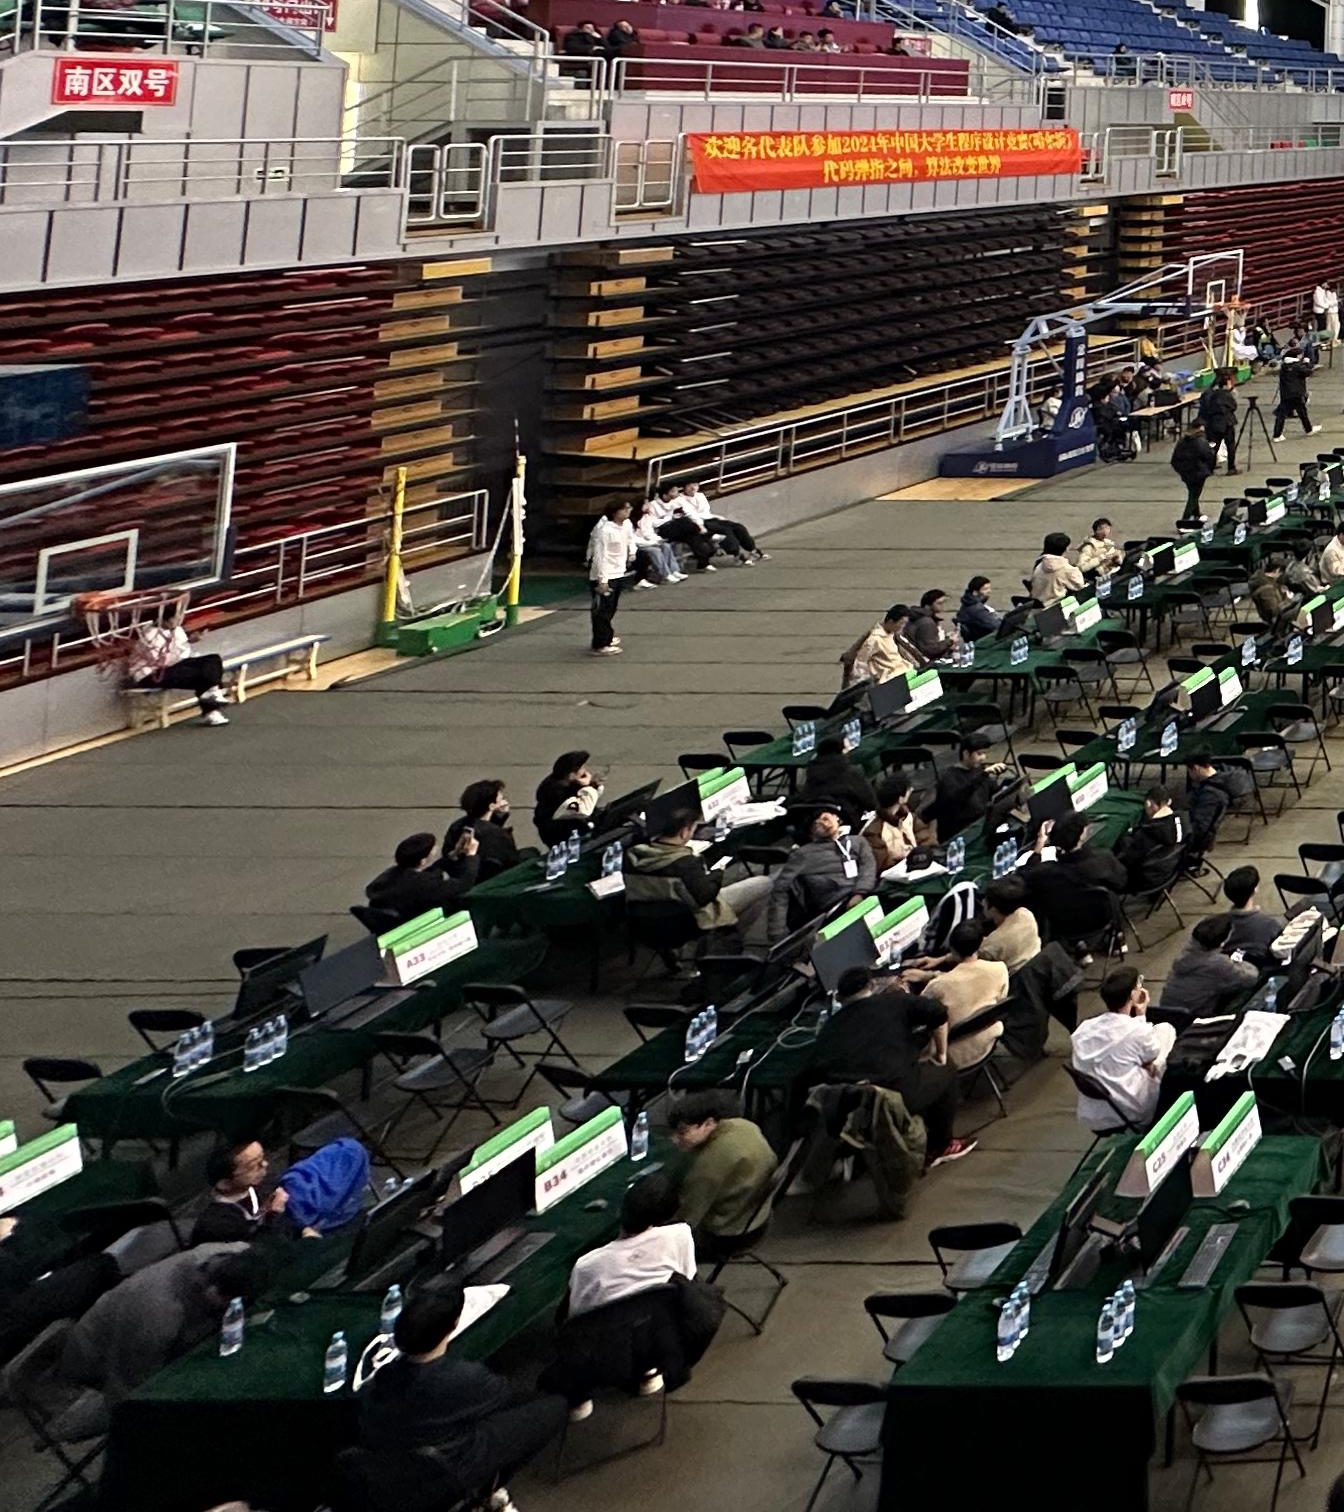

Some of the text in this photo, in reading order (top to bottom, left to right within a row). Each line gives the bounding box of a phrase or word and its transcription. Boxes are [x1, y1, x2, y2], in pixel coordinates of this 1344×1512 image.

[64, 67, 170, 98] 南区双号
[406, 952, 426, 969] A33
[544, 1169, 567, 1193] B34
